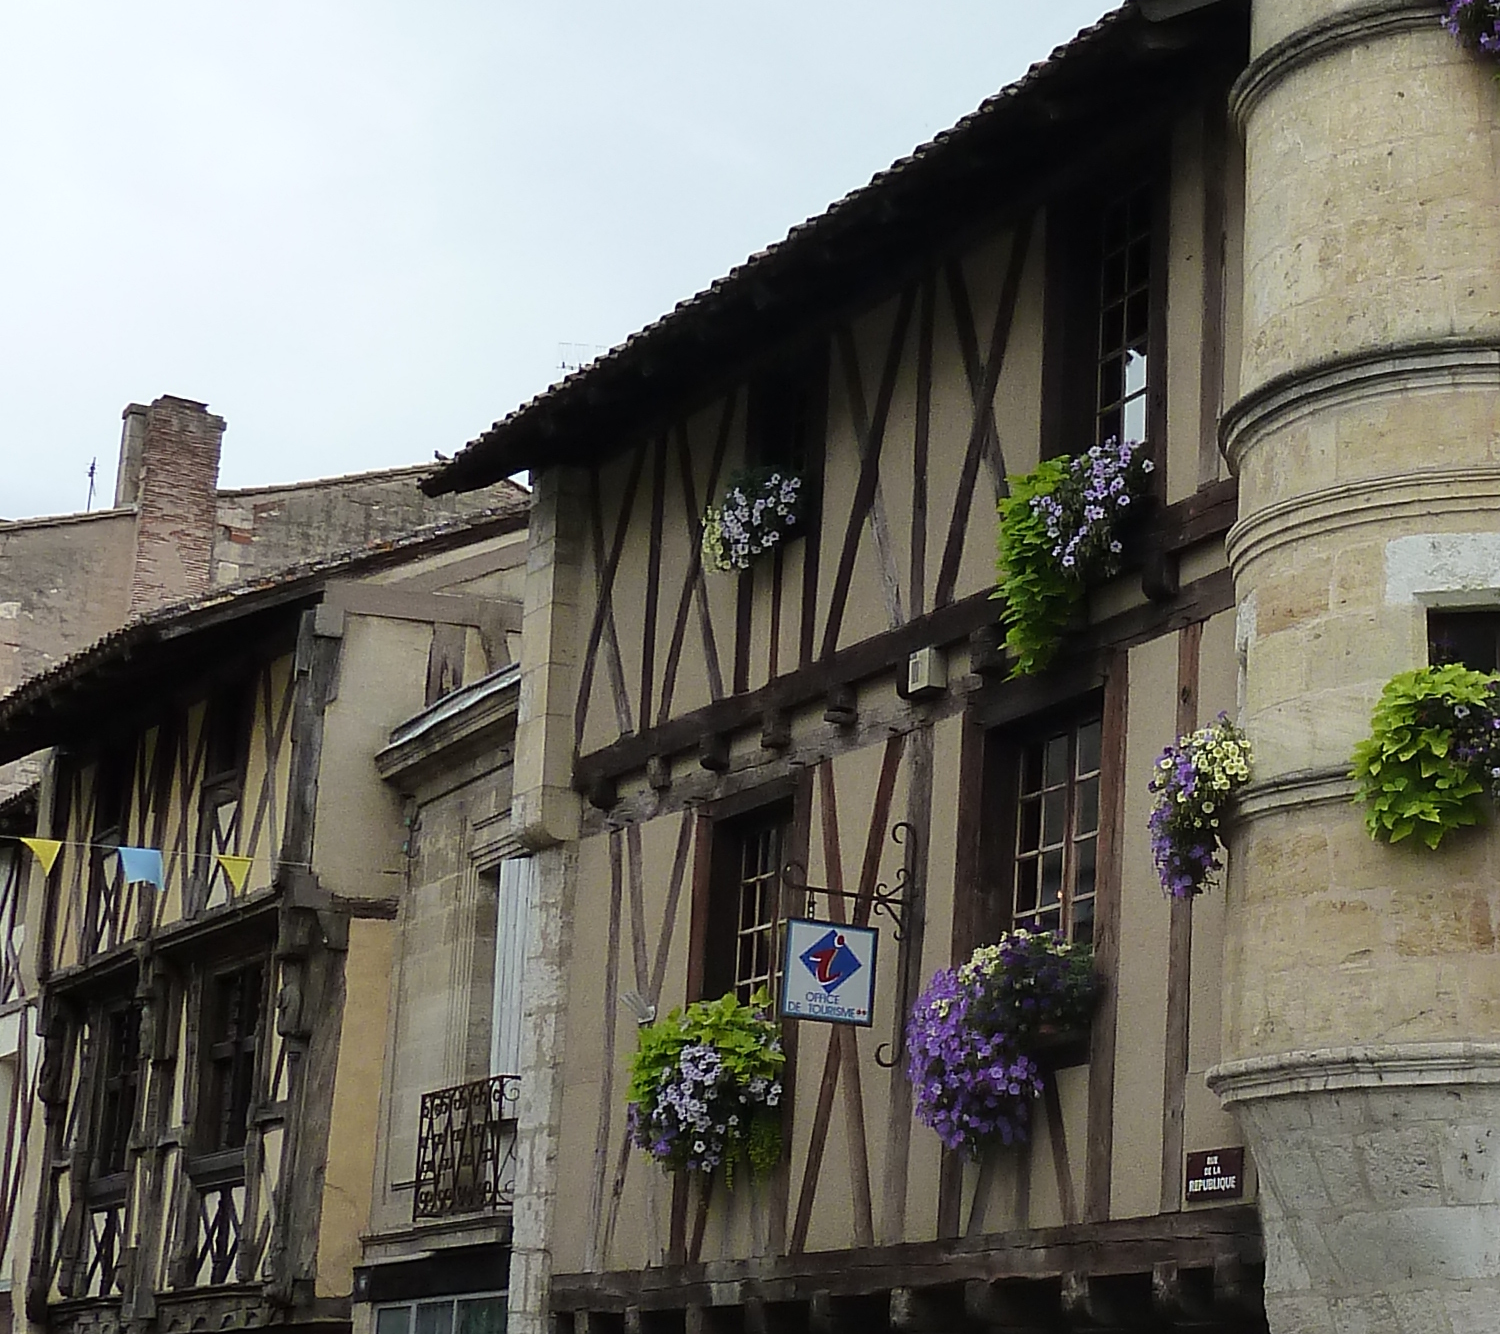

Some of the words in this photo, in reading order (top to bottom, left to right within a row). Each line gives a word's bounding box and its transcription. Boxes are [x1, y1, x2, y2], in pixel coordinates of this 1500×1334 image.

[805, 991, 840, 1004] OFFICE
[788, 1001, 801, 1013] DE
[808, 1004, 856, 1018] TOURISME
[1213, 1166, 1221, 1175] LA
